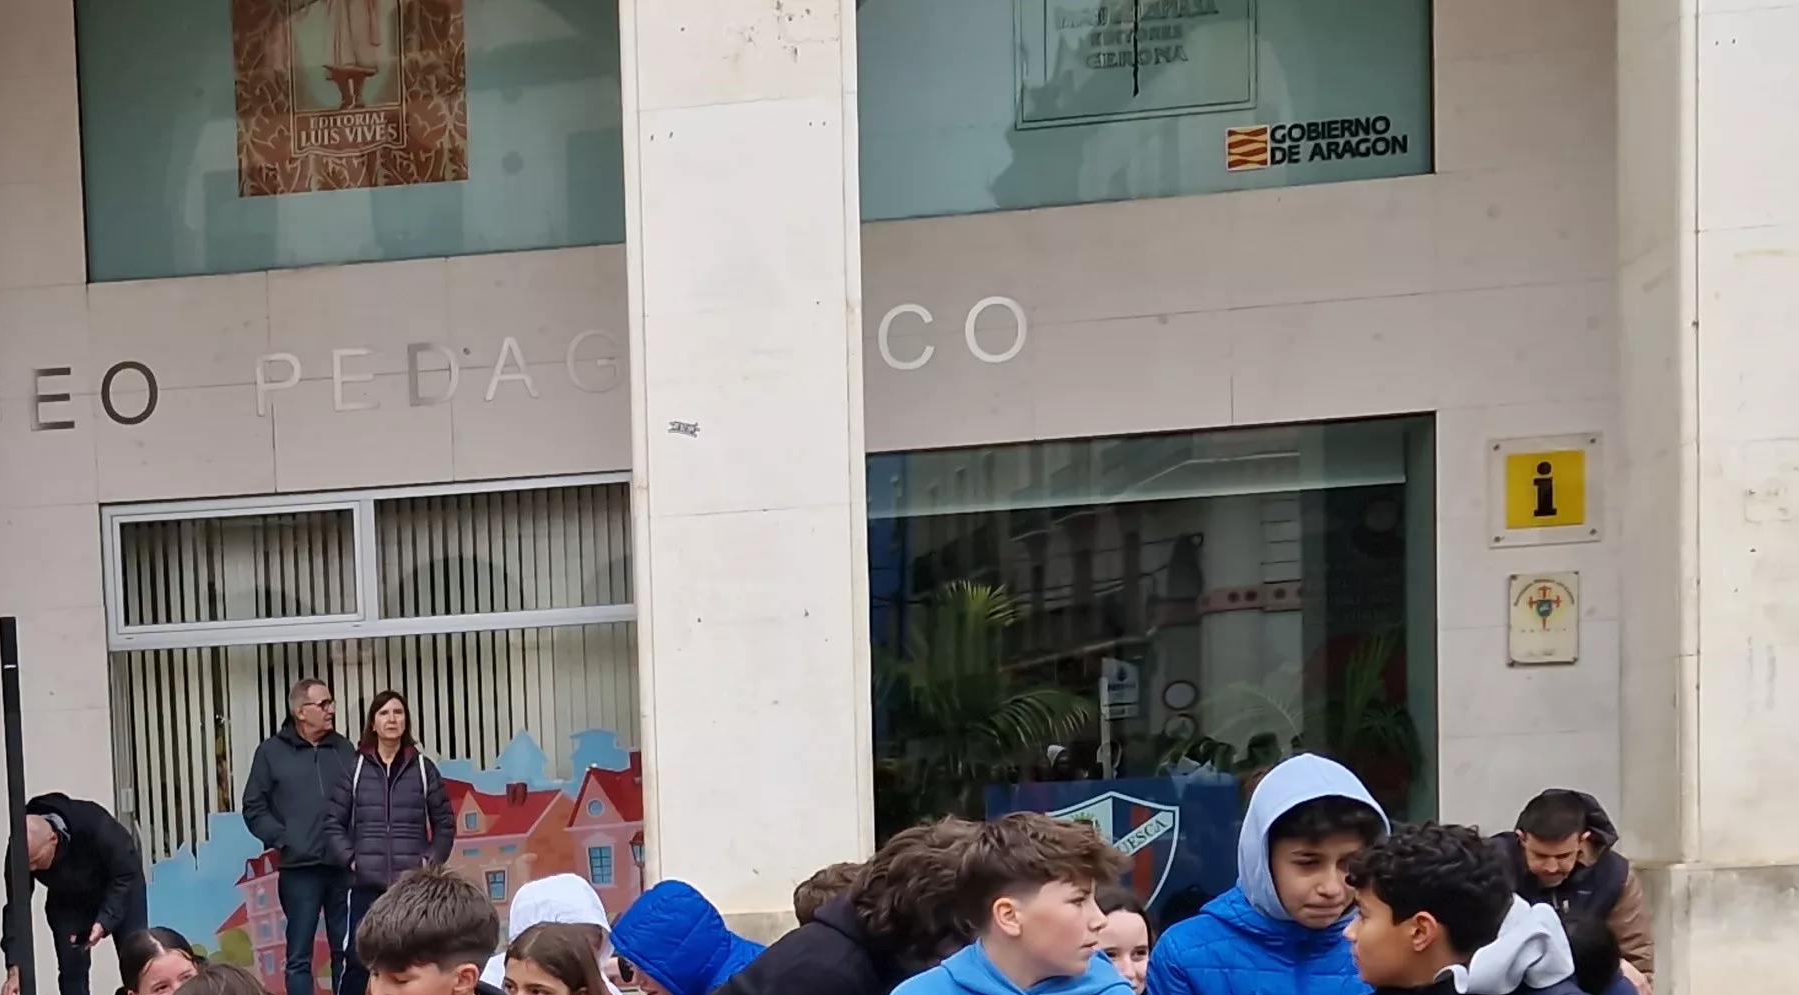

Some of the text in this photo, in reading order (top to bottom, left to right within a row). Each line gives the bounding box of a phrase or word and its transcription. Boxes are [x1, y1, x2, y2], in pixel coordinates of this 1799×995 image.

[309, 112, 388, 129] EDITORIAL
[1270, 116, 1391, 144] GOBIERNO
[301, 123, 398, 147] LUIS VIVES
[1270, 135, 1408, 165] DE ARAGON
